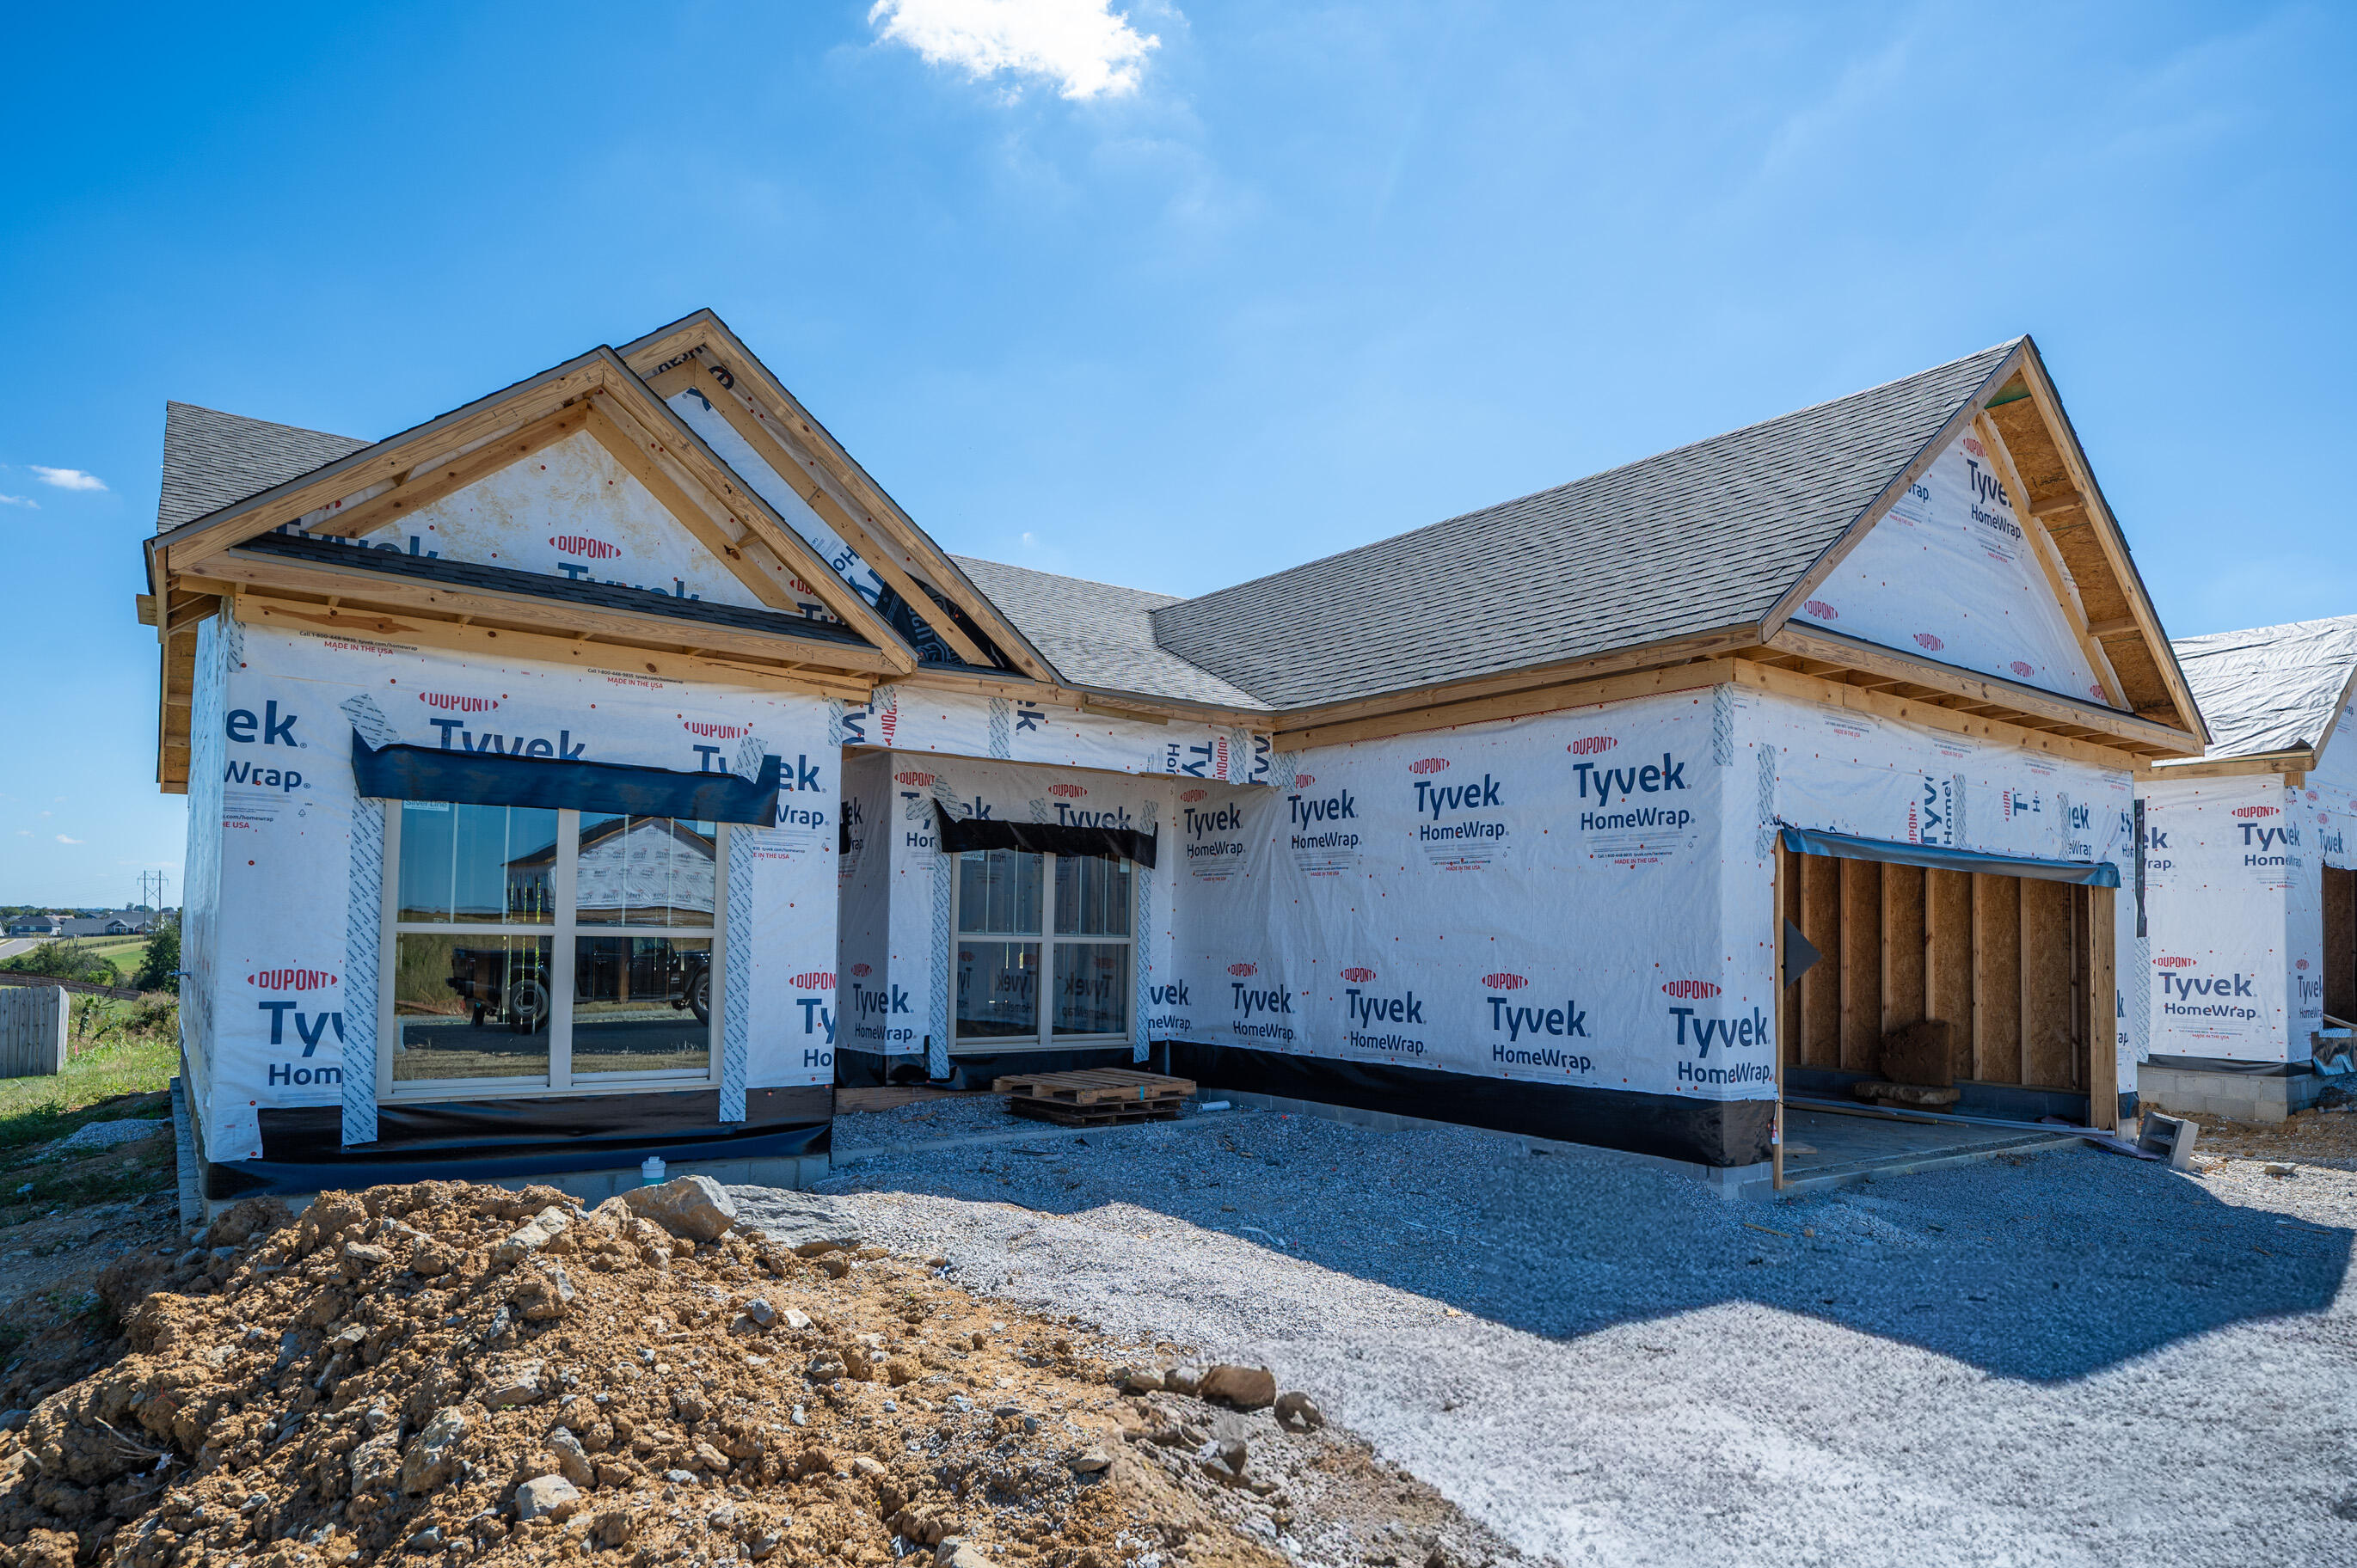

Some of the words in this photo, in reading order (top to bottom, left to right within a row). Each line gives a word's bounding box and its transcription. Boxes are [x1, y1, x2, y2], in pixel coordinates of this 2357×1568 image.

[1967, 459, 2012, 508] Tyve
[1972, 503, 2021, 541] HomeWrap
[558, 535, 614, 560] DUPONT
[1808, 600, 1835, 621] DUPONT
[324, 641, 348, 650] MADE
[1918, 633, 1942, 652] DUPONT
[607, 677, 627, 685] MADE
[1573, 736, 1613, 755] DUPONT
[1216, 742, 1228, 781] DUPONT
[1414, 757, 1446, 775] DUPONT
[899, 772, 936, 787] DUPONT
[1573, 753, 1686, 807] Tyvek
[1053, 784, 1083, 798] DUPONT
[1183, 789, 1205, 803] DUPONT
[1414, 774, 1501, 820] Tyvek
[1054, 803, 1131, 830] Tyvek
[1184, 802, 1243, 840] Tyvek
[1287, 789, 1356, 831] Tyvek
[1581, 807, 1690, 831] HomeWrap
[2237, 806, 2274, 818] DUPONT
[1292, 831, 1359, 852] HomeWrap
[1420, 821, 1506, 842] HomeWrap
[2237, 821, 2300, 851] Tyvek
[2318, 828, 2344, 854] Tyvek
[1187, 840, 1243, 858] HomeWrap
[2244, 854, 2301, 870] HomeWrap
[1231, 964, 1255, 977] DUPONT
[2158, 957, 2193, 968] DUPONT
[259, 969, 328, 990] DUPONT
[1345, 967, 1372, 983] DUPONT
[1487, 973, 1524, 989] DUPONT
[2158, 971, 2252, 1001] Tyvek
[1231, 983, 1292, 1018] Tyvek
[1669, 980, 1716, 999] DUPONT
[853, 983, 909, 1020] Tyvek
[1346, 989, 1423, 1028] Tyvek
[2164, 1002, 2256, 1020] HomeWrap
[1487, 996, 1587, 1042] Tyvek
[855, 1023, 912, 1043] HomeWrap
[1233, 1020, 1293, 1043] HomeWrap
[1669, 1007, 1767, 1058] Tyvek
[1350, 1032, 1423, 1057] HomeWrap
[1493, 1044, 1591, 1074] HomeWrap
[1679, 1060, 1769, 1084] HomeWrap
